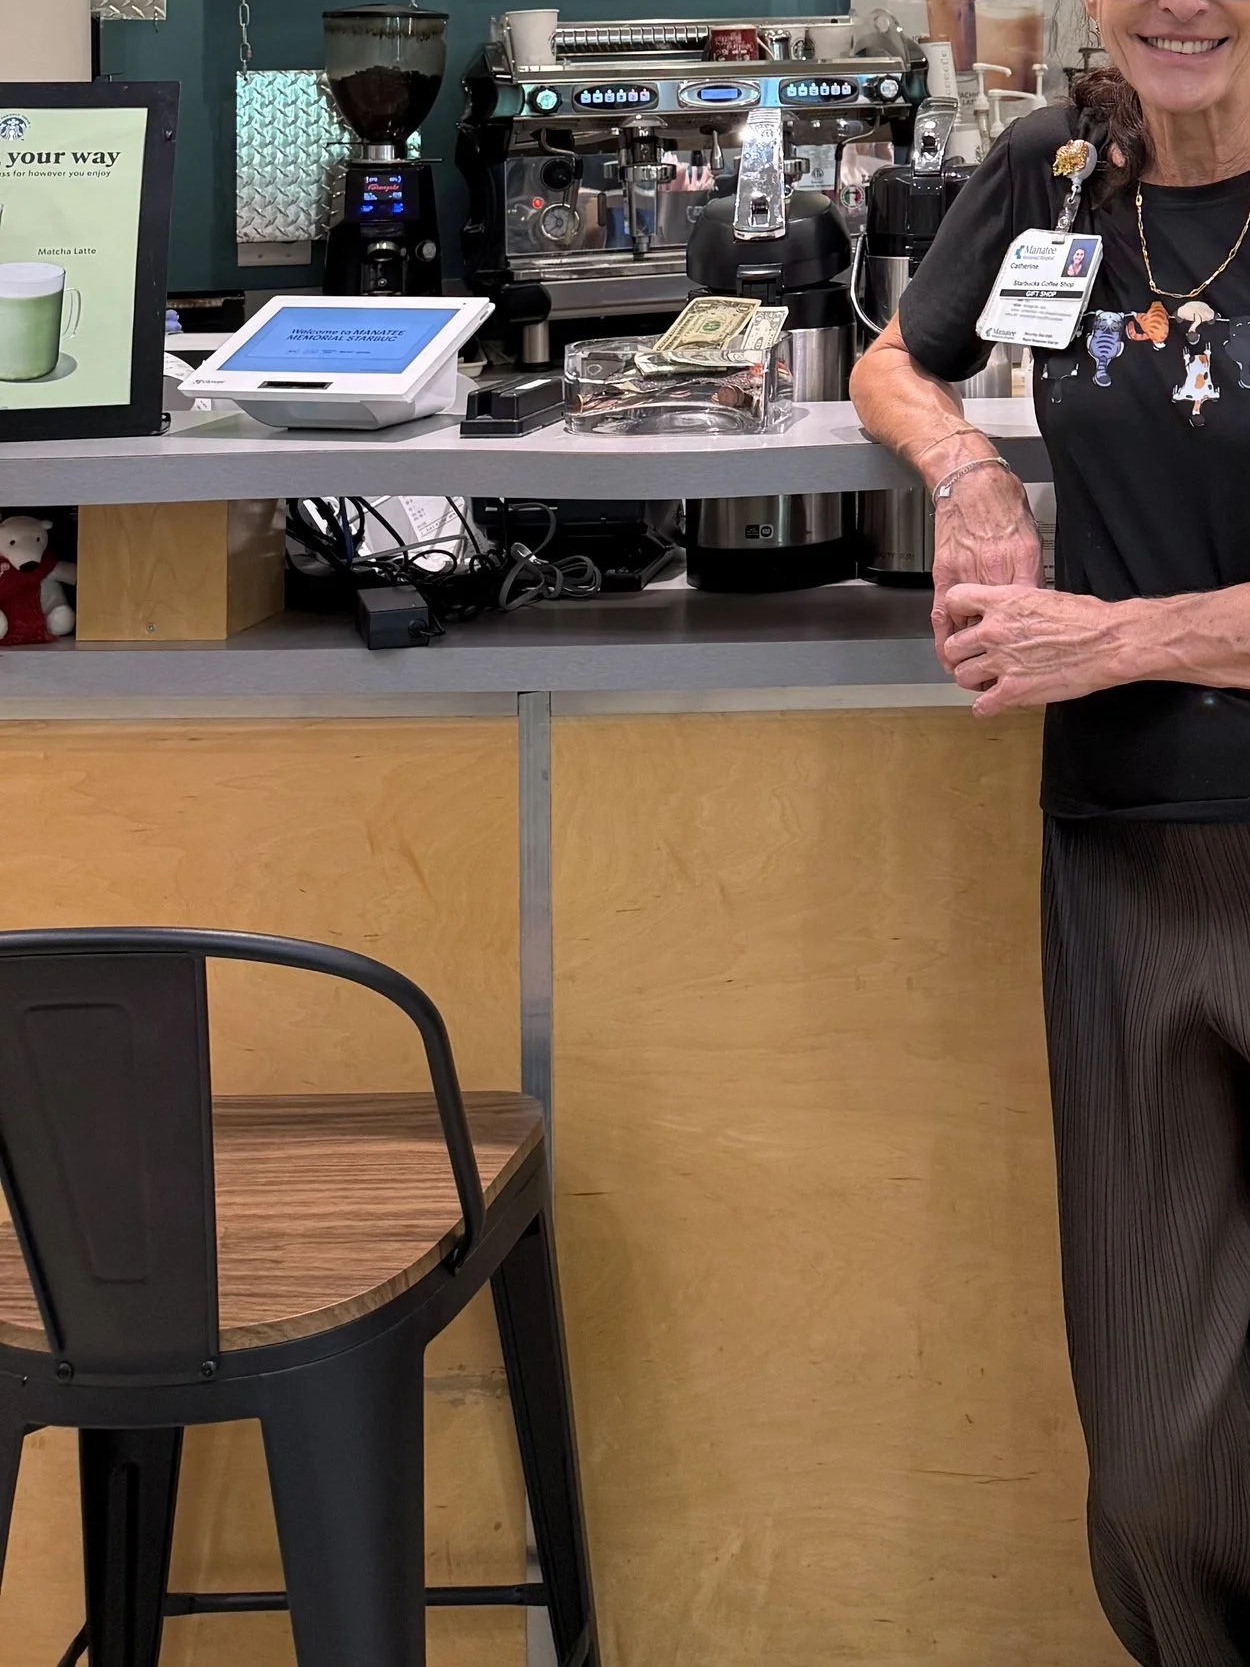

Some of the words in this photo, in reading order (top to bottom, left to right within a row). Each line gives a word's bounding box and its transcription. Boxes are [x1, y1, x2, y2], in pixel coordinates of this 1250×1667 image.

[5, 151, 66, 169] your
[71, 151, 121, 168] way
[87, 170, 111, 178] enjoy
[38, 248, 71, 256] Matcha
[74, 247, 97, 255] Latte
[1024, 245, 1057, 256] Manatee
[1010, 262, 1040, 270] Catherine
[286, 334, 344, 342] MEMORIAL
